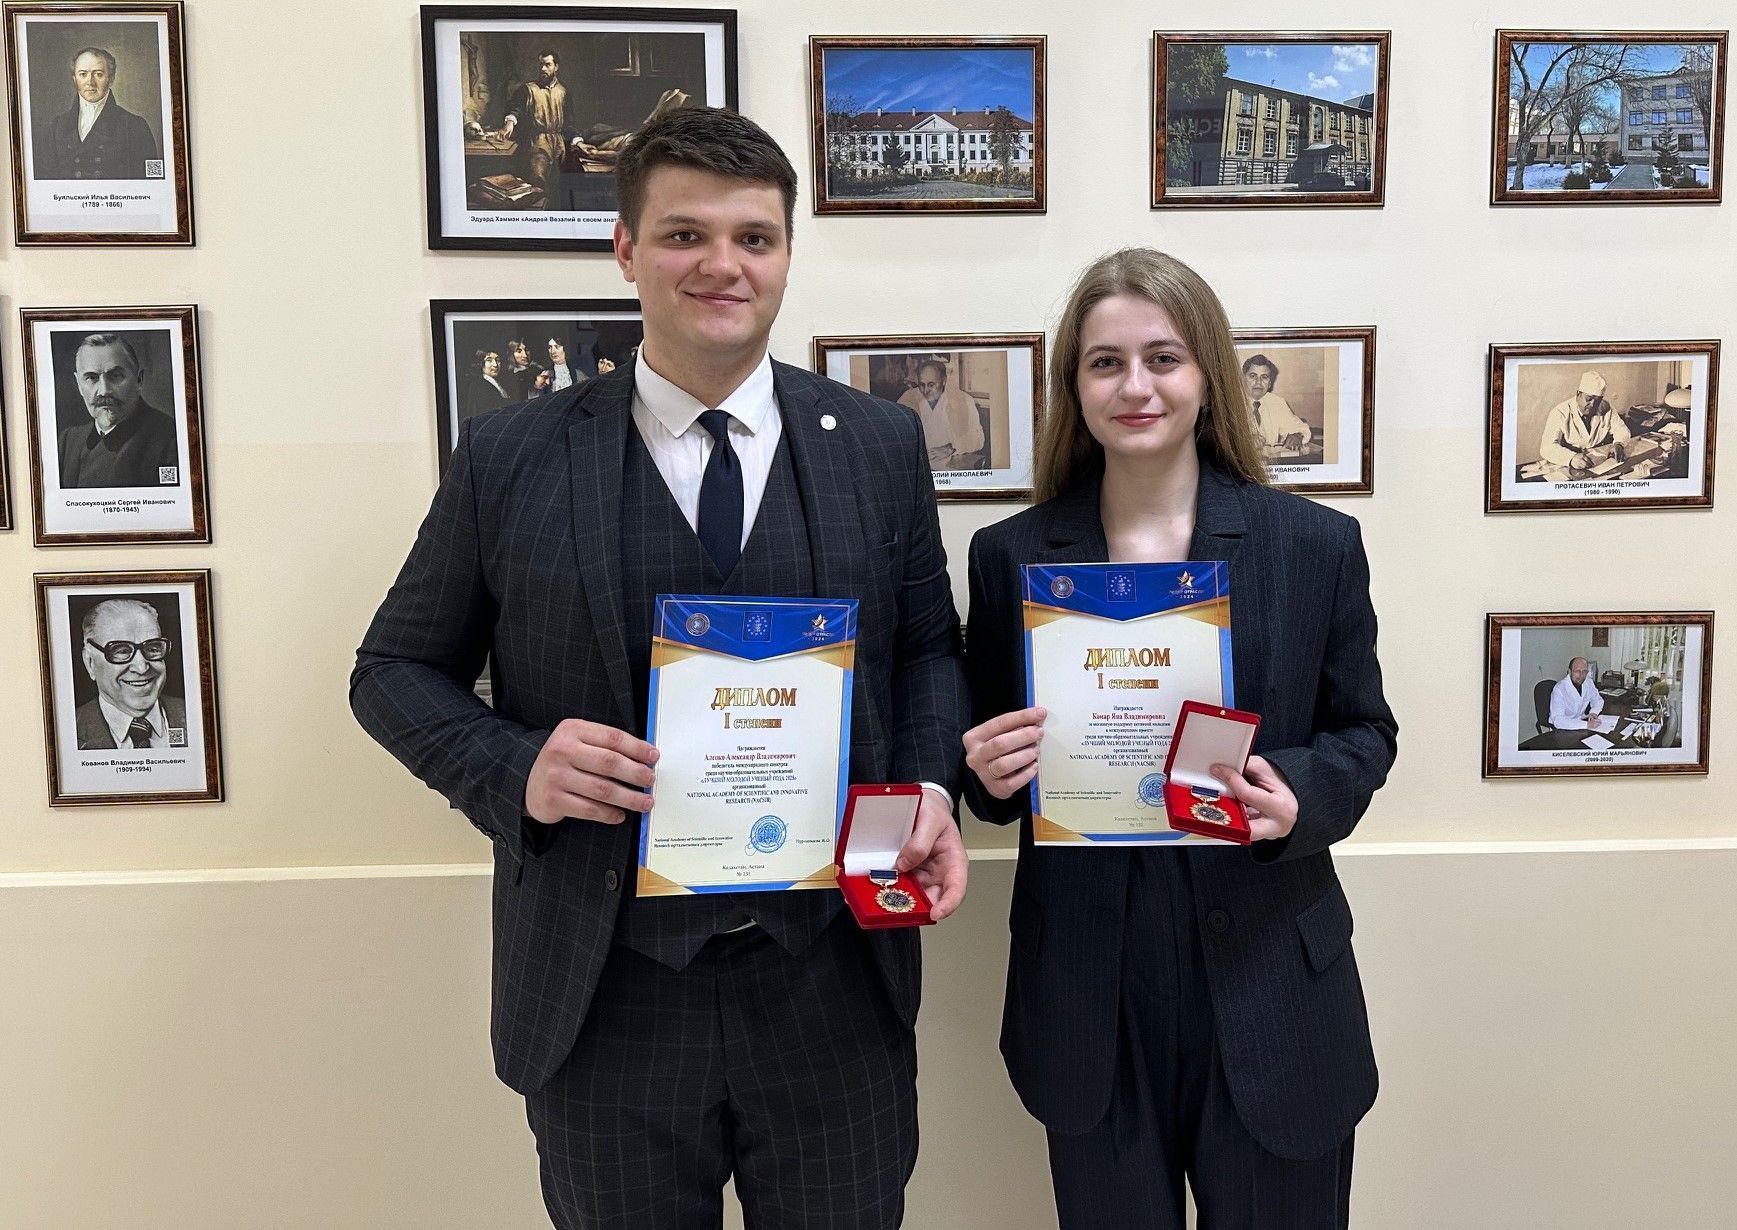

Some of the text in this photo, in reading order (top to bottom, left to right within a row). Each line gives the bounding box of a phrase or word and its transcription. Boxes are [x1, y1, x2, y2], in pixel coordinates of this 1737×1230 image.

[1084, 648, 1170, 670] ДИПЛОМ
[1108, 679, 1159, 689] степени
[710, 688, 797, 710] ДИПЛОМ
[1124, 712, 1166, 721] Владимировна
[733, 718, 782, 729] степени
